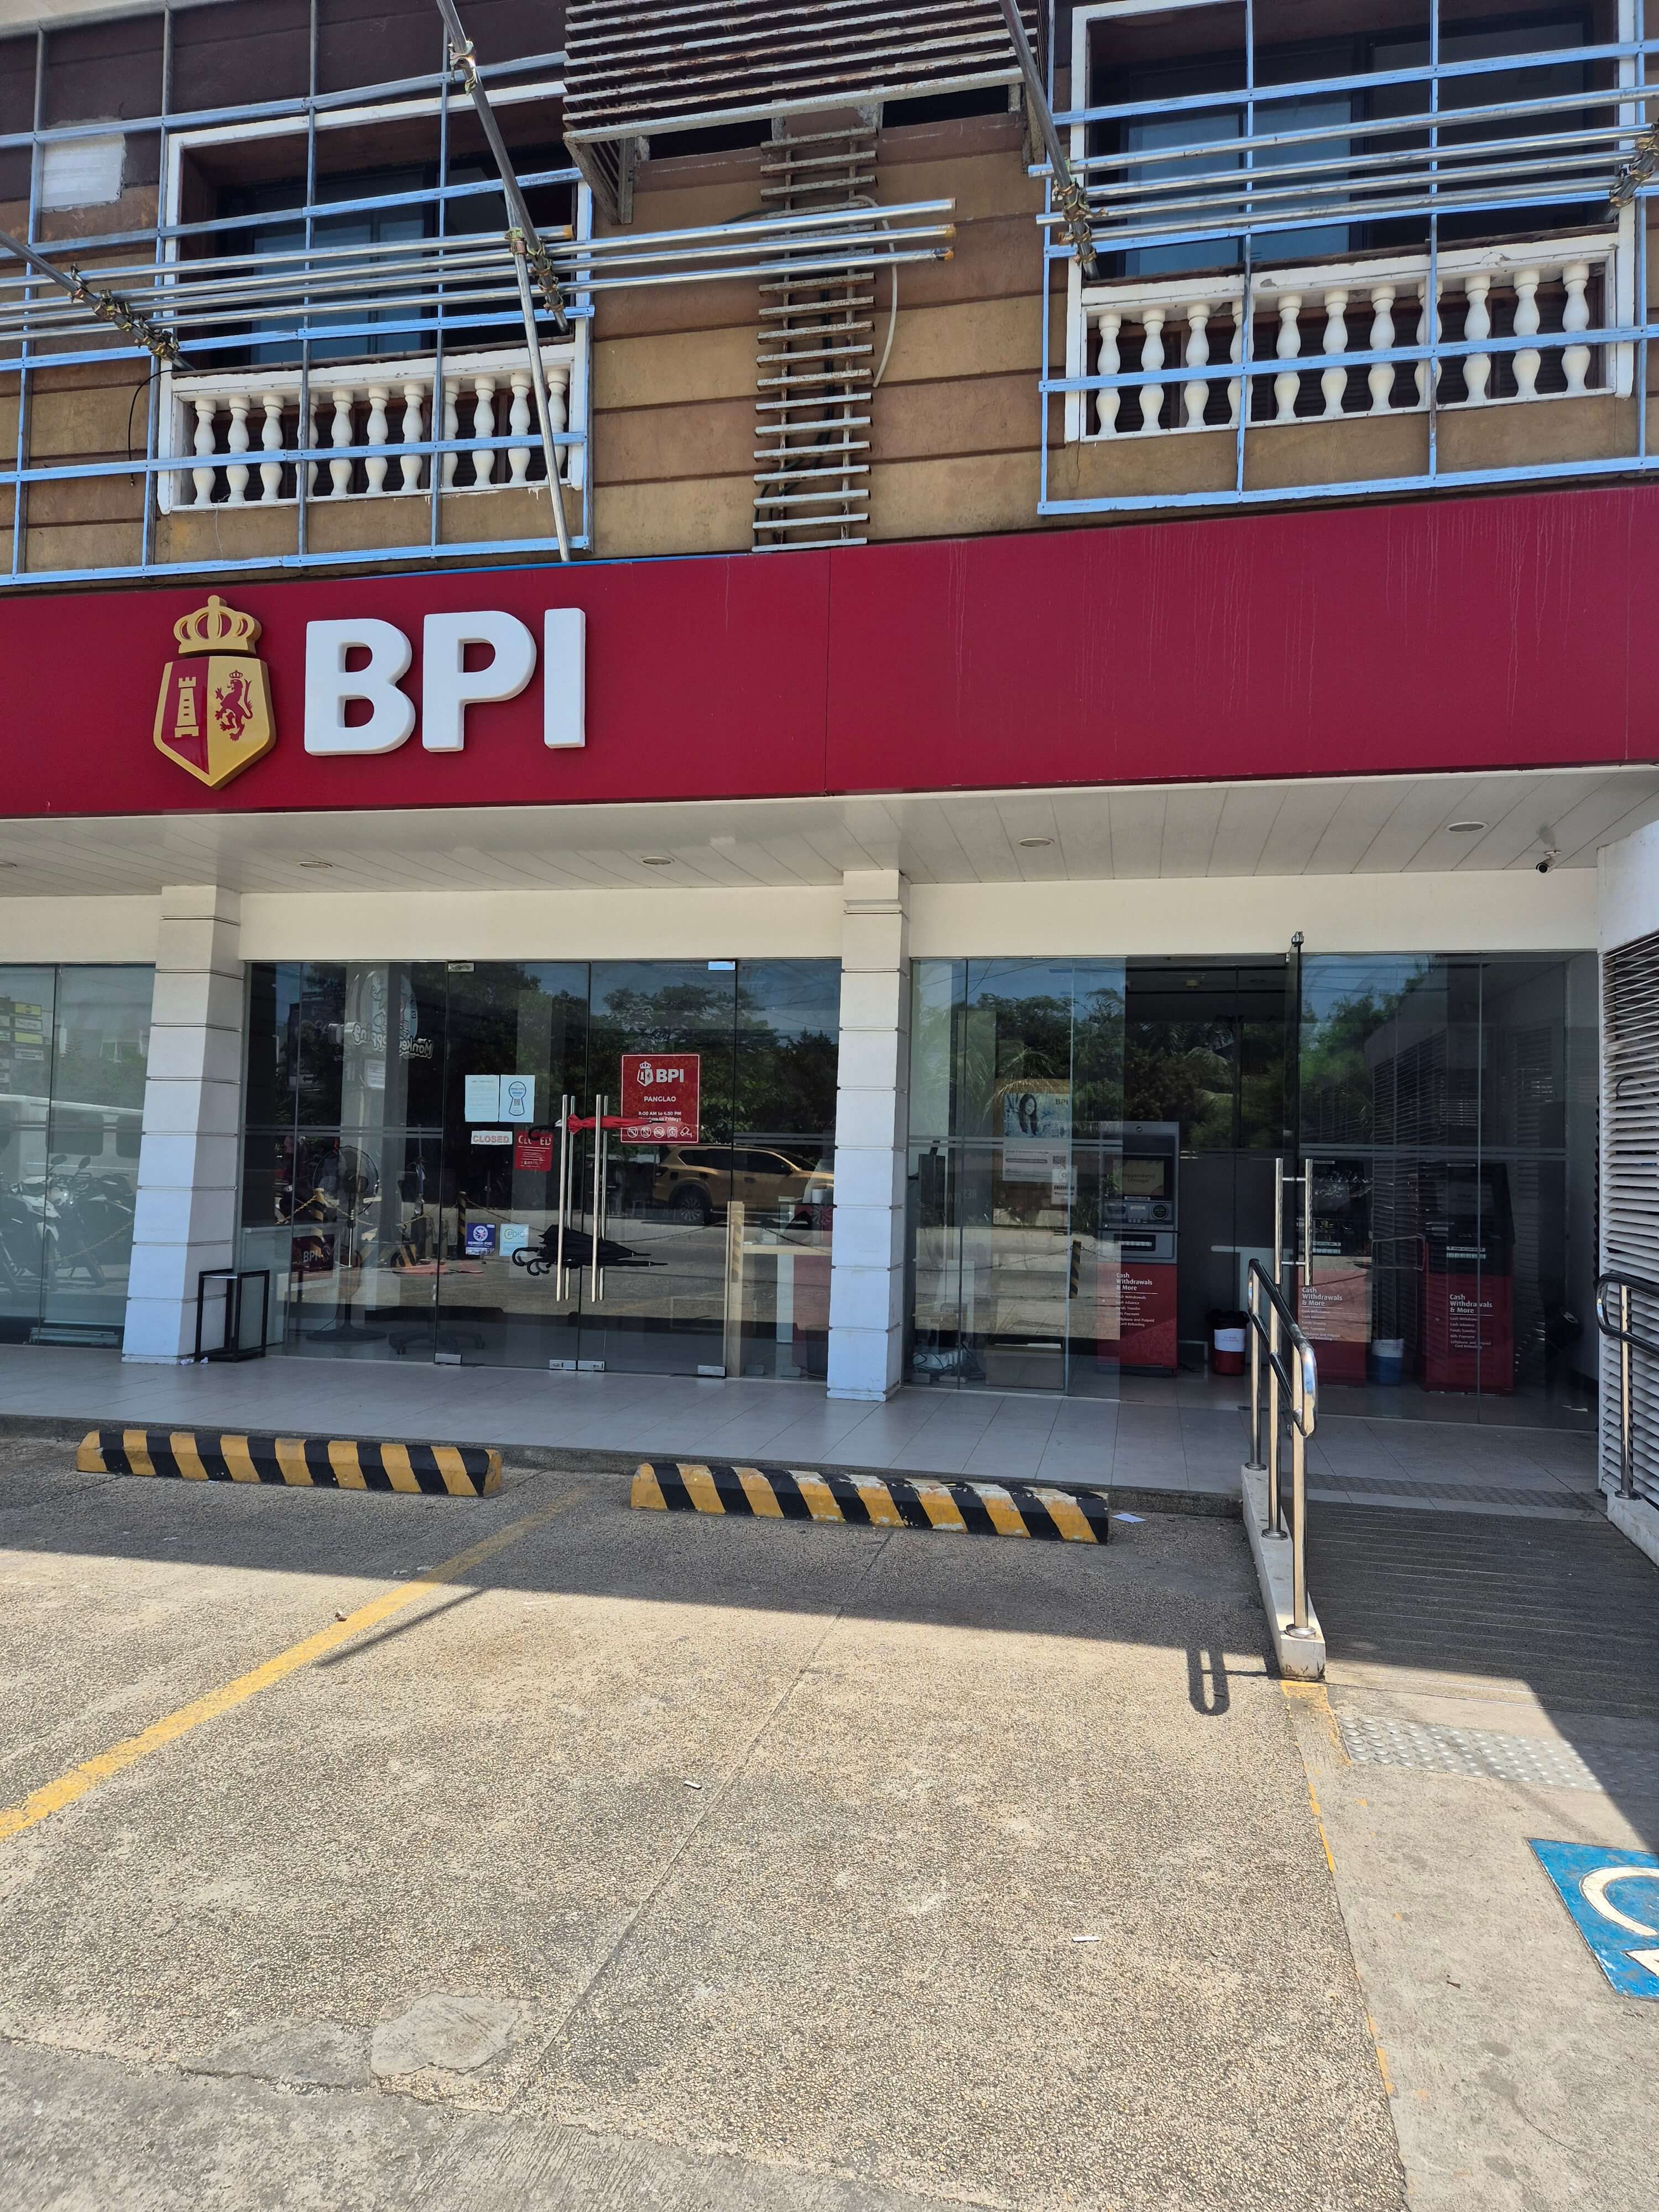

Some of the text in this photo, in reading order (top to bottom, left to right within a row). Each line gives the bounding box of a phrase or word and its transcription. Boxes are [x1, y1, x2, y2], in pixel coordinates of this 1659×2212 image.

[305, 607, 586, 755] BPI
[656, 1069, 684, 1083] BPI
[473, 1135, 509, 1143] CLOSED
[518, 1135, 551, 1146] CLED
[304, 1250, 317, 1262] BPI
